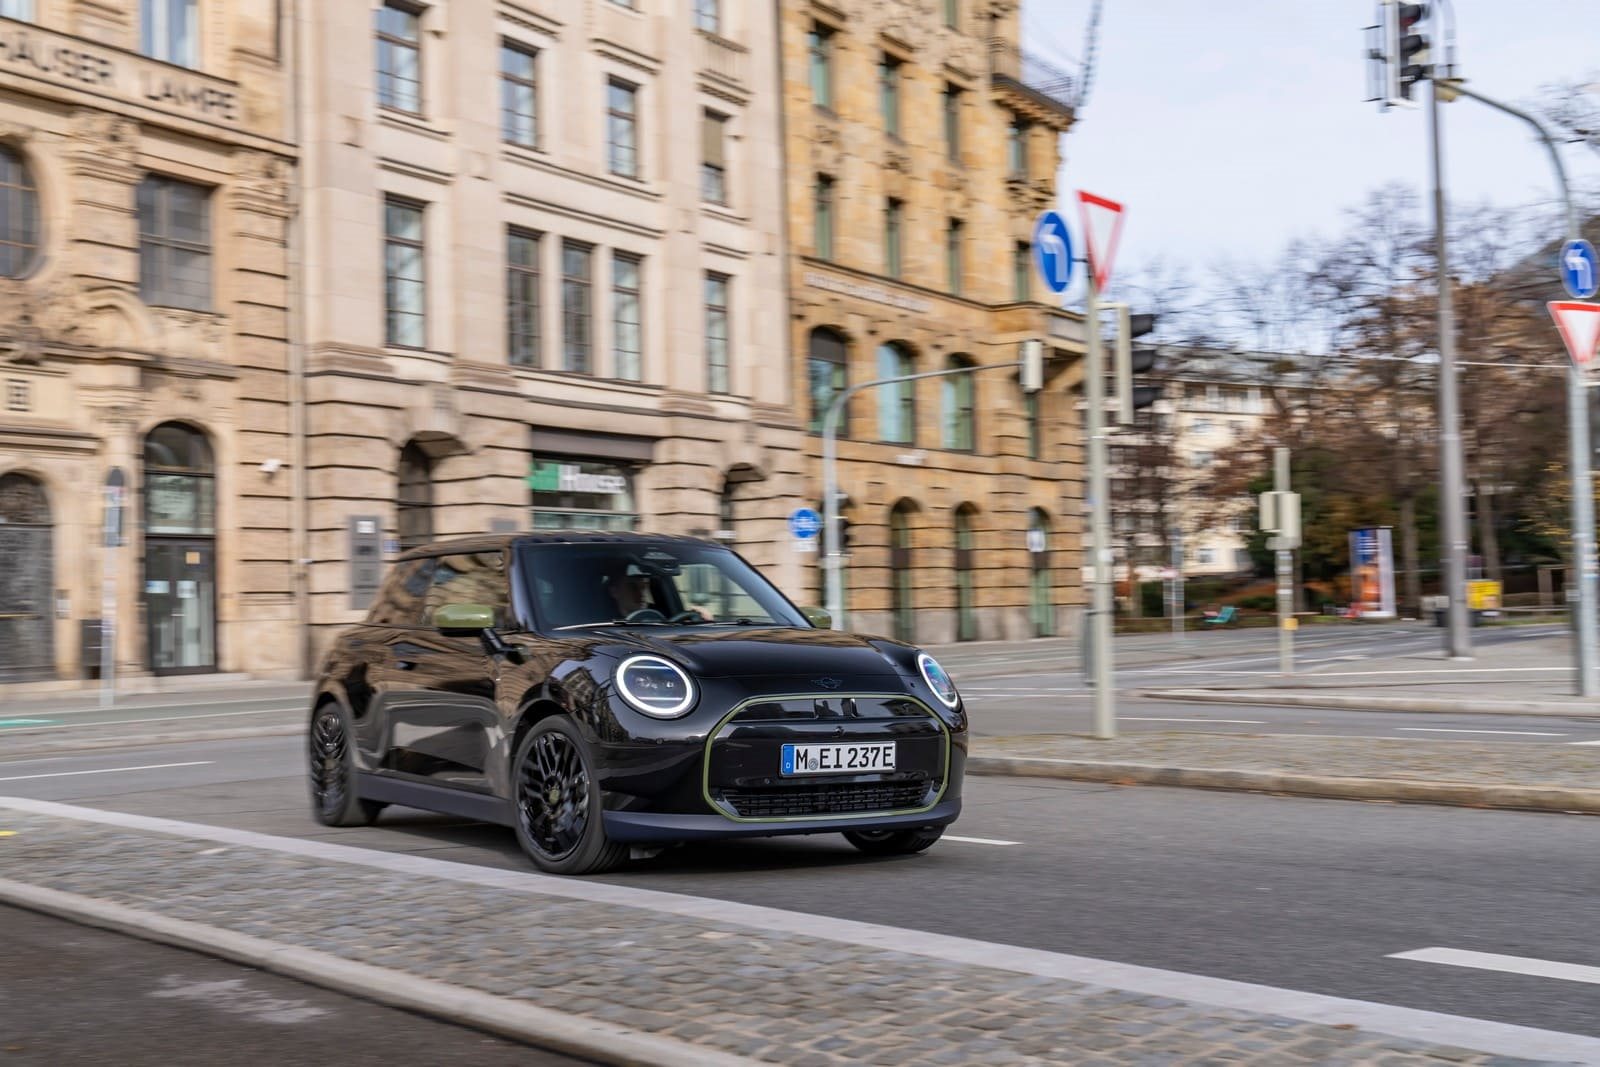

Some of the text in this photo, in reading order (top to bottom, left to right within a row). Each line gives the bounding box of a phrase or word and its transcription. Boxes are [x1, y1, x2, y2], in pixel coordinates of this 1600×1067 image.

[142, 69, 237, 120] LAMPE
[796, 746, 893, 770] M EI 237E
